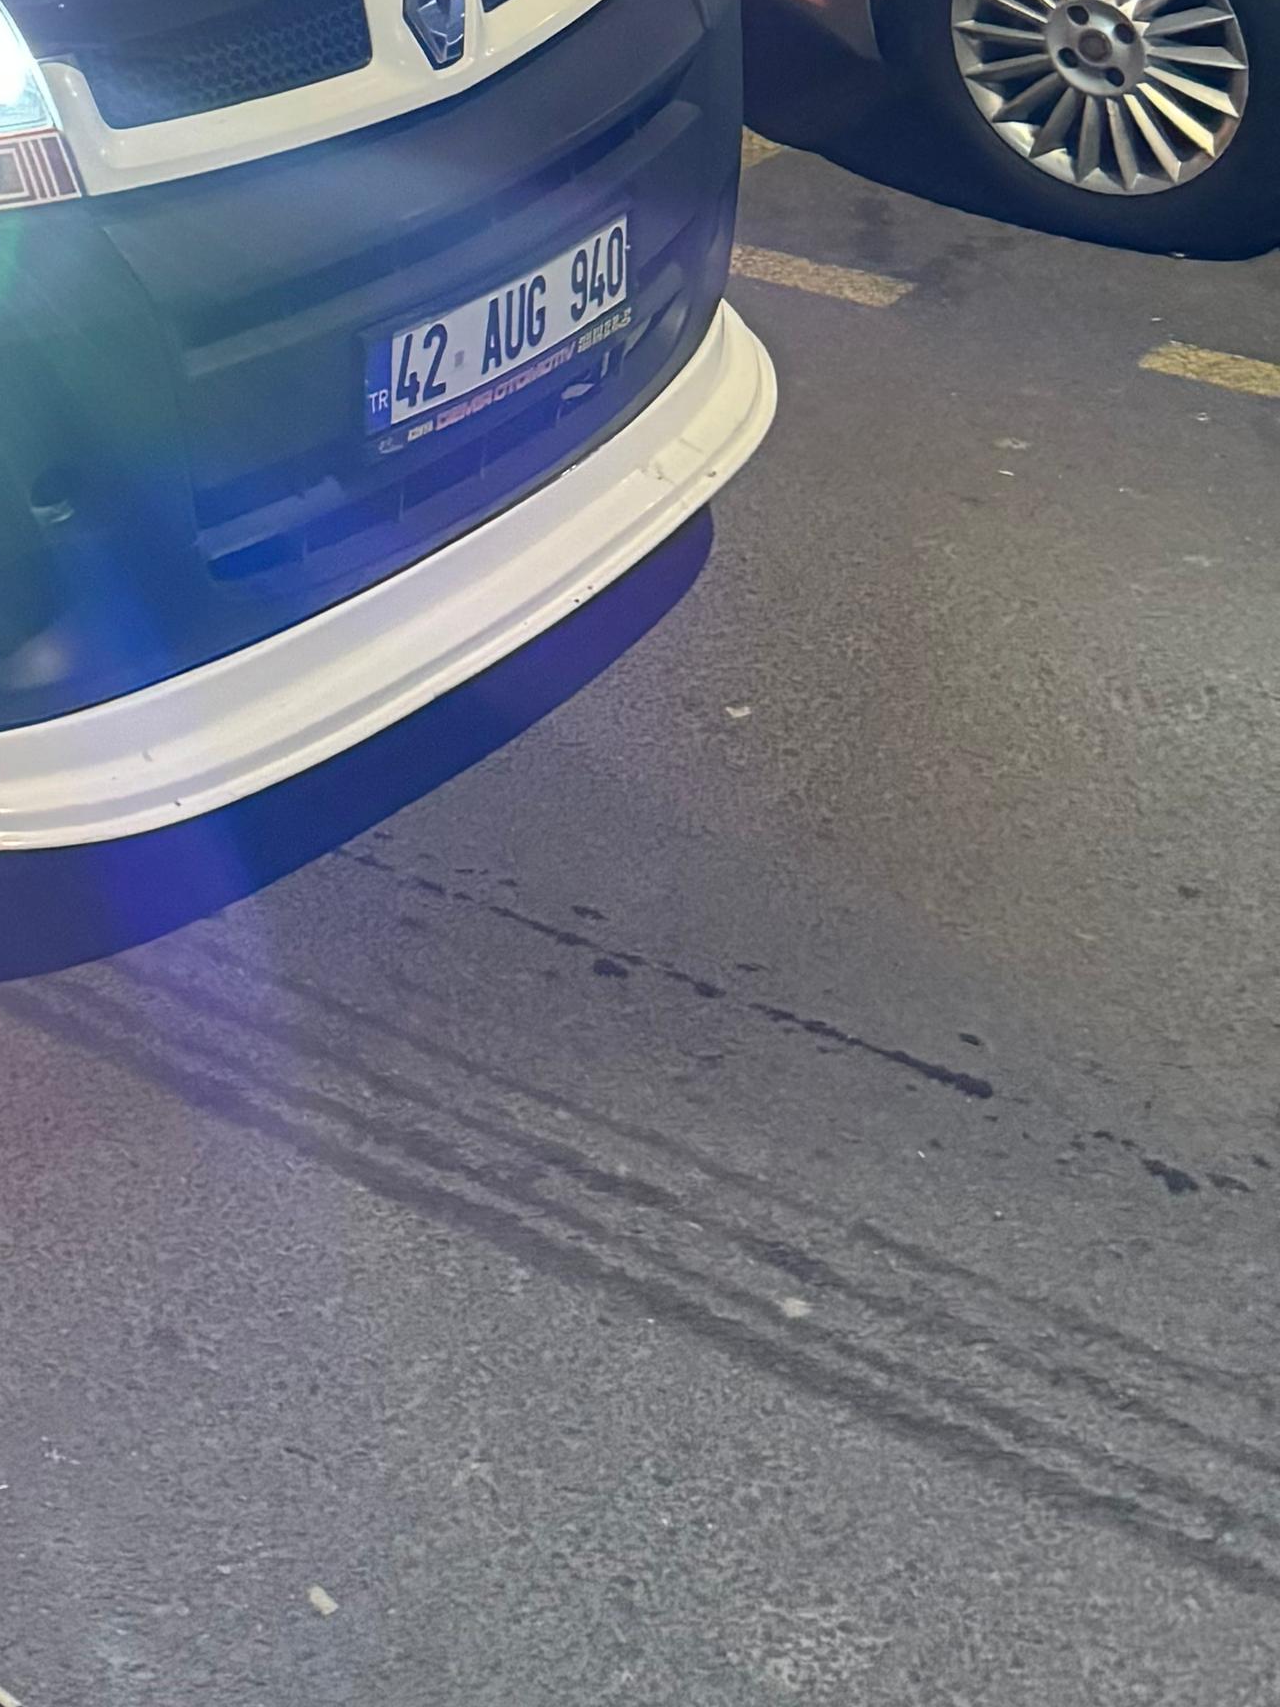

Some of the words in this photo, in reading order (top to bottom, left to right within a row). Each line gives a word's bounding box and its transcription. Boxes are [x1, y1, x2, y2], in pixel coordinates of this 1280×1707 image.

[395, 323, 448, 408] 42
[481, 274, 547, 375] AUG
[570, 226, 626, 322] 940
[367, 389, 389, 414] TR
